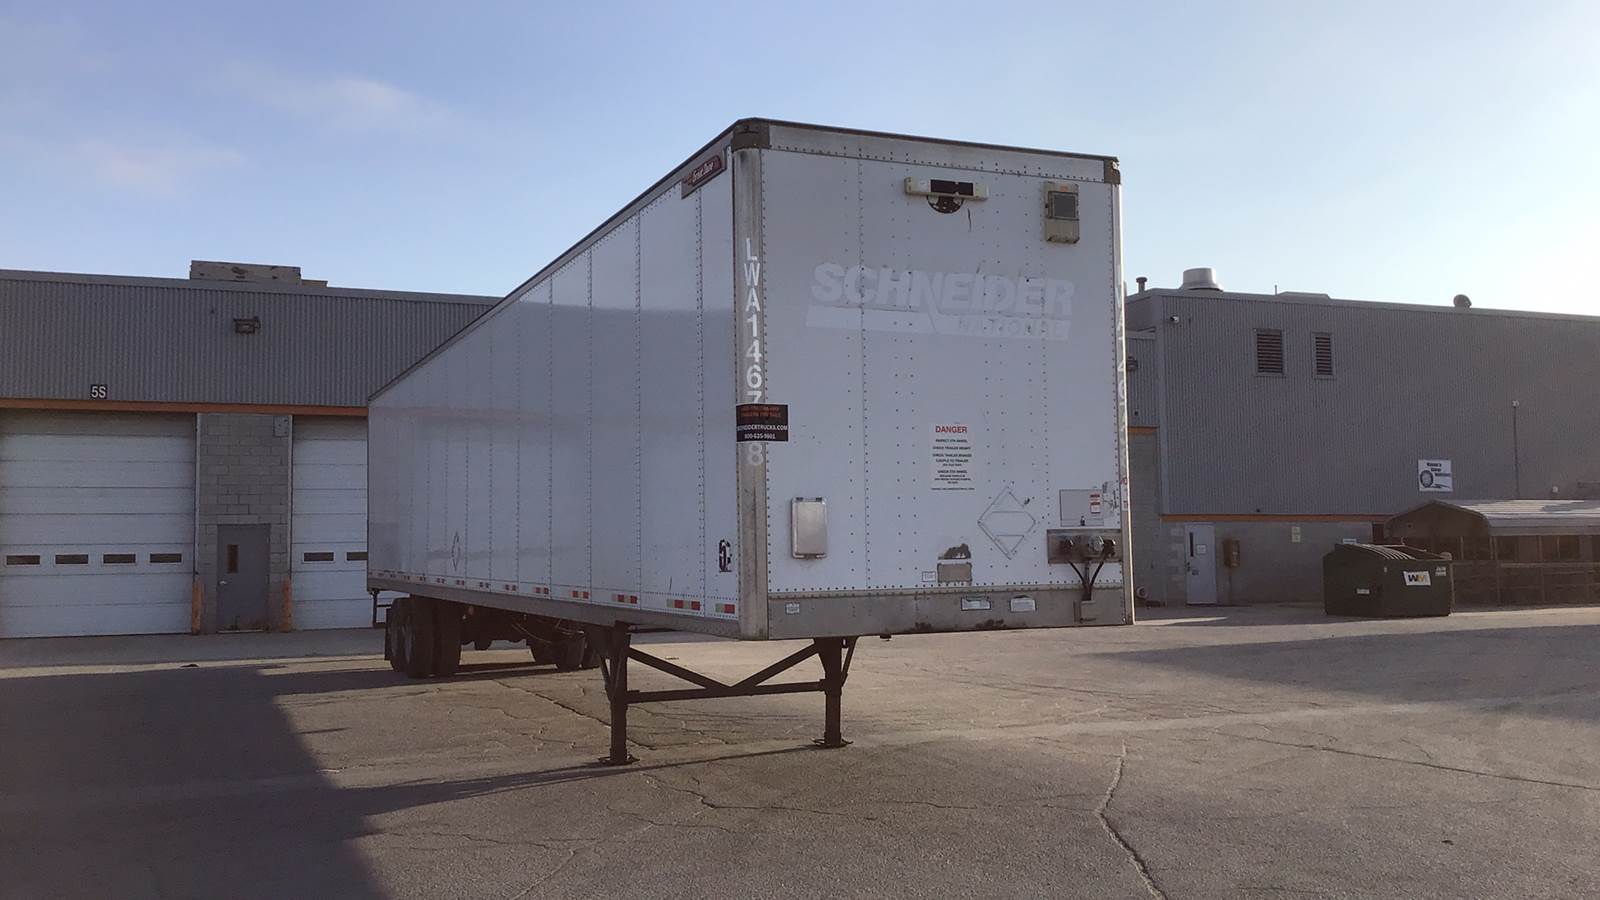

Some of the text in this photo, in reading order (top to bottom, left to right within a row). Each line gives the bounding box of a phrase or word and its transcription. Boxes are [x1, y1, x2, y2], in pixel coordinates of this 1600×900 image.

[811, 262, 1075, 316] SCHNEIDER
[91, 385, 106, 398] 5S
[935, 425, 968, 433] DANGER
